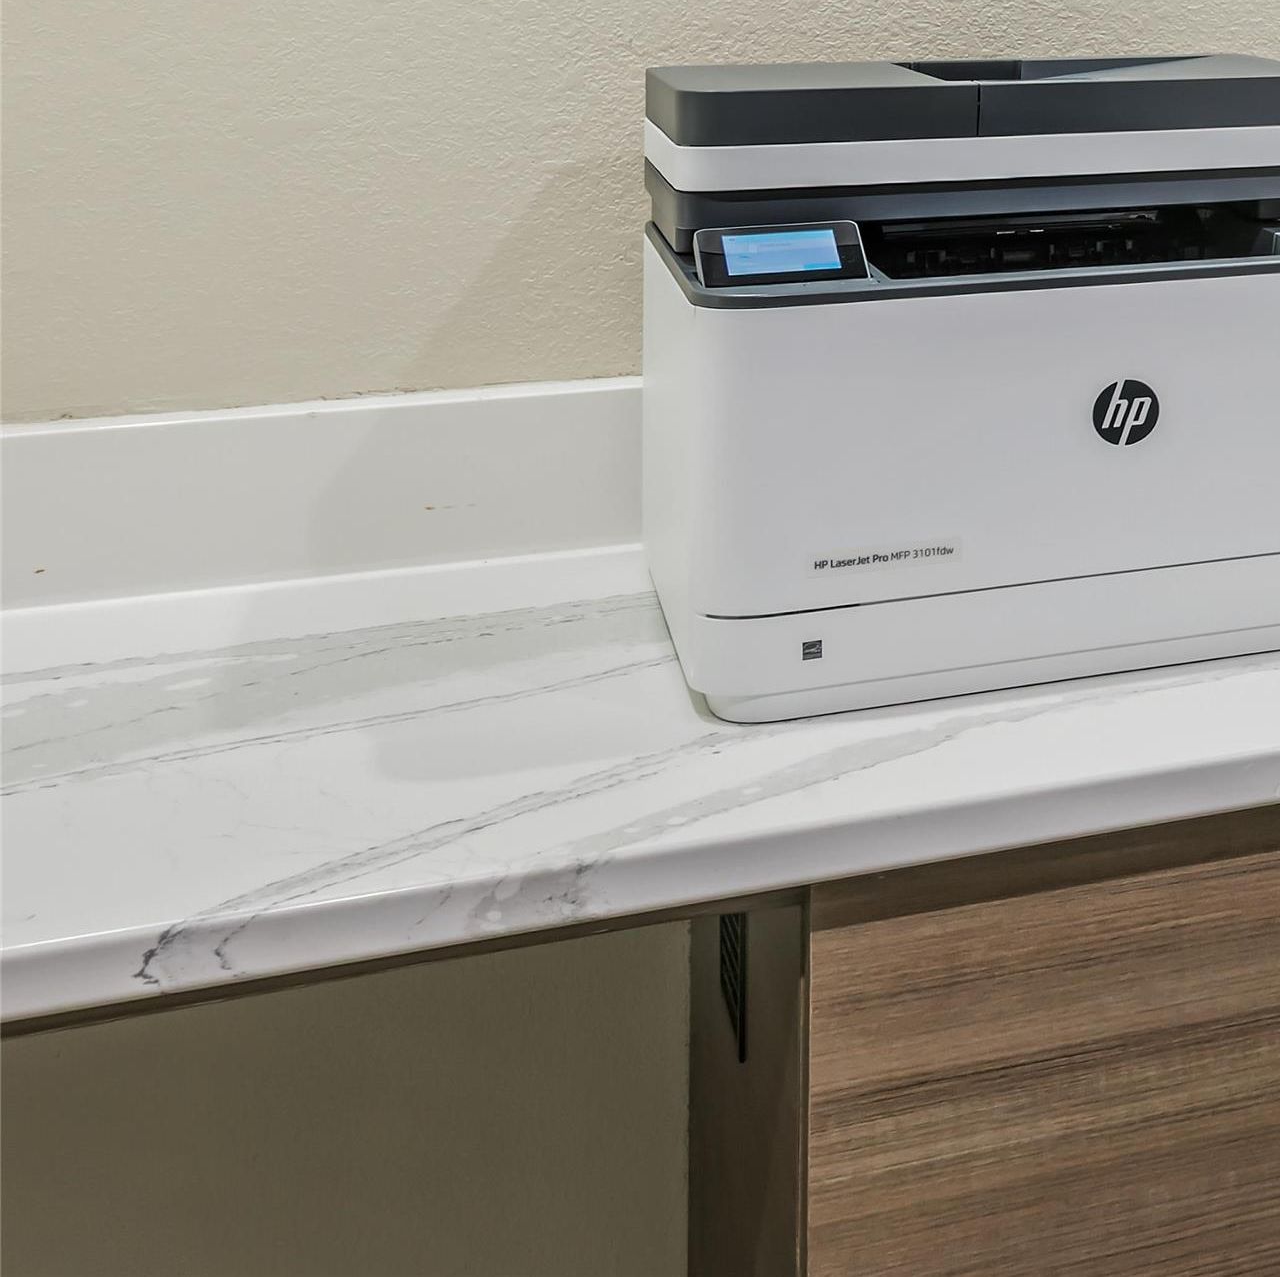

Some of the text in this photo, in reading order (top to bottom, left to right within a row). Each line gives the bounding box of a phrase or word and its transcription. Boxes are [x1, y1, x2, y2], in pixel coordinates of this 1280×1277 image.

[1101, 379, 1153, 446] hp
[814, 546, 954, 570] HP LaserJet Pro MFP 3101fdw
